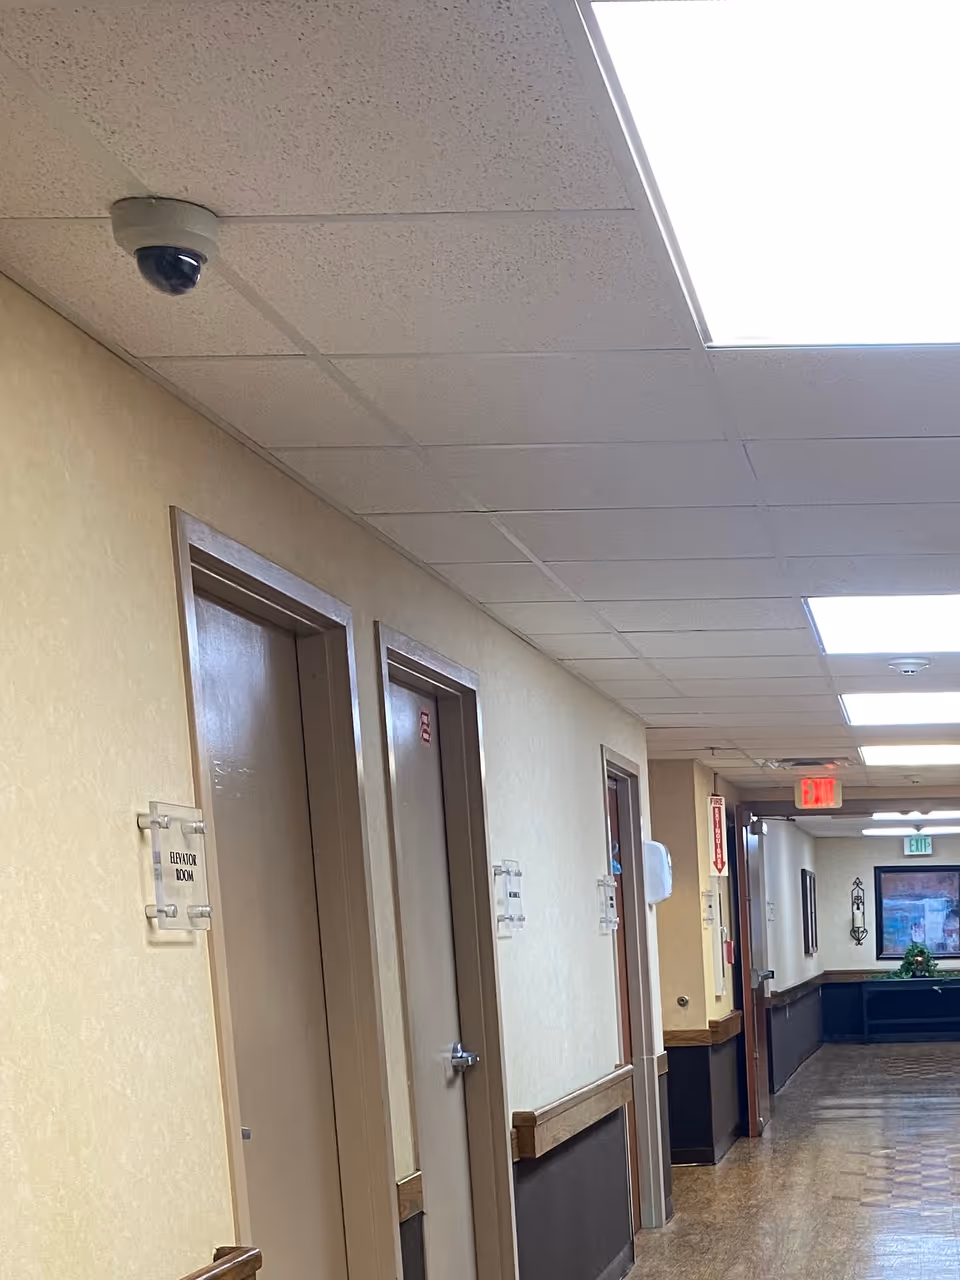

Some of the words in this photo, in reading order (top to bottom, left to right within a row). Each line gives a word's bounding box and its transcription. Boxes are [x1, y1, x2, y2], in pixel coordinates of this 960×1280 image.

[801, 778, 835, 807] EXIT
[710, 797, 723, 806] FIRE
[909, 838, 927, 853] EXIT
[169, 851, 197, 866] ELEVATOR
[175, 868, 194, 882] ROOM
